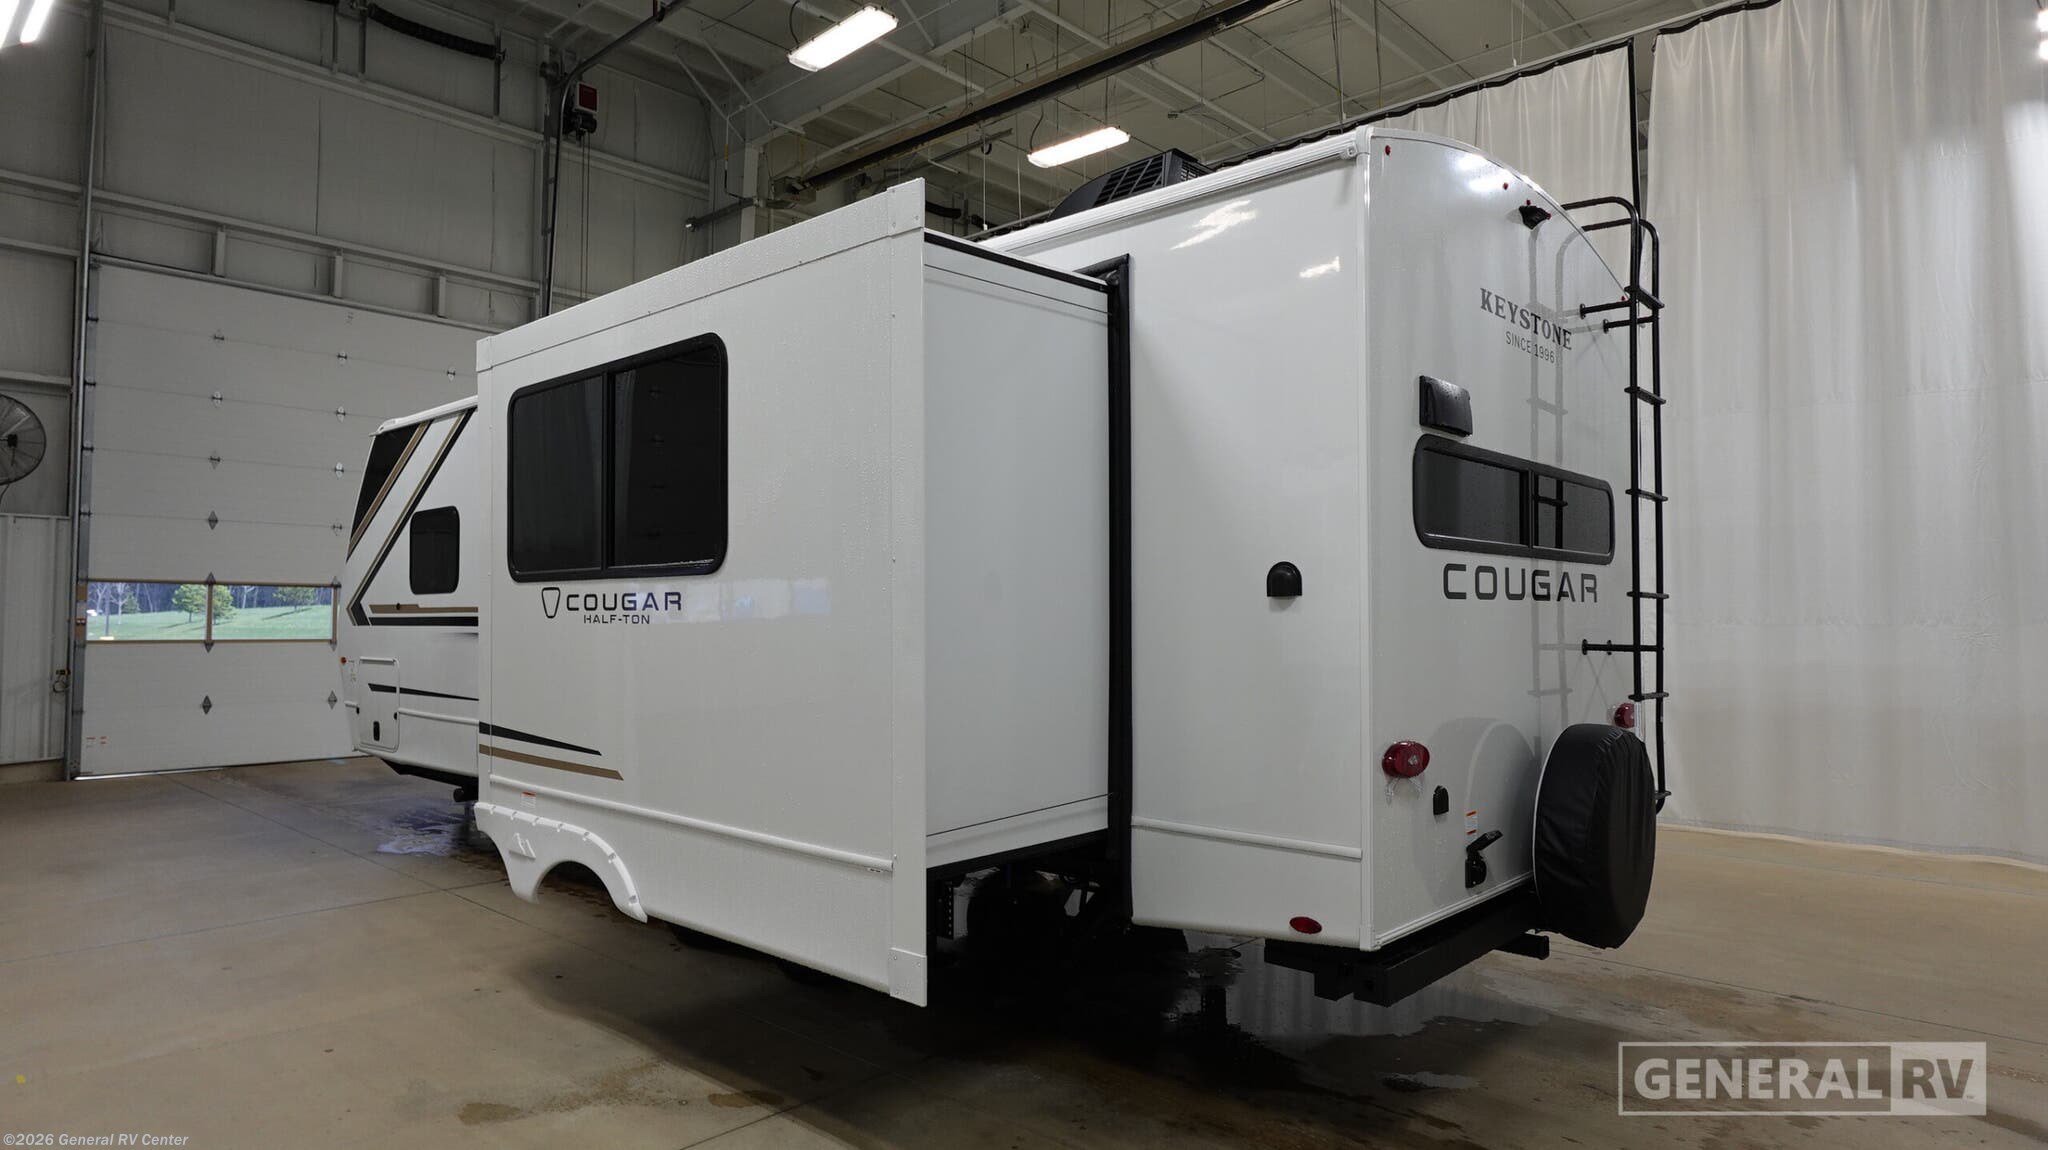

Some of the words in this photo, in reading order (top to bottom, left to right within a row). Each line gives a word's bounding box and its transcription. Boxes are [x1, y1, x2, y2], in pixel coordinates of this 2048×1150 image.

[1480, 288, 1572, 350] KEYSTONE
[1505, 331, 1531, 353] SINCE
[1534, 343, 1555, 363] 1996
[1443, 563, 1597, 603] COUGAR
[566, 592, 682, 611] COUGAR
[583, 614, 650, 624] HALF-TON
